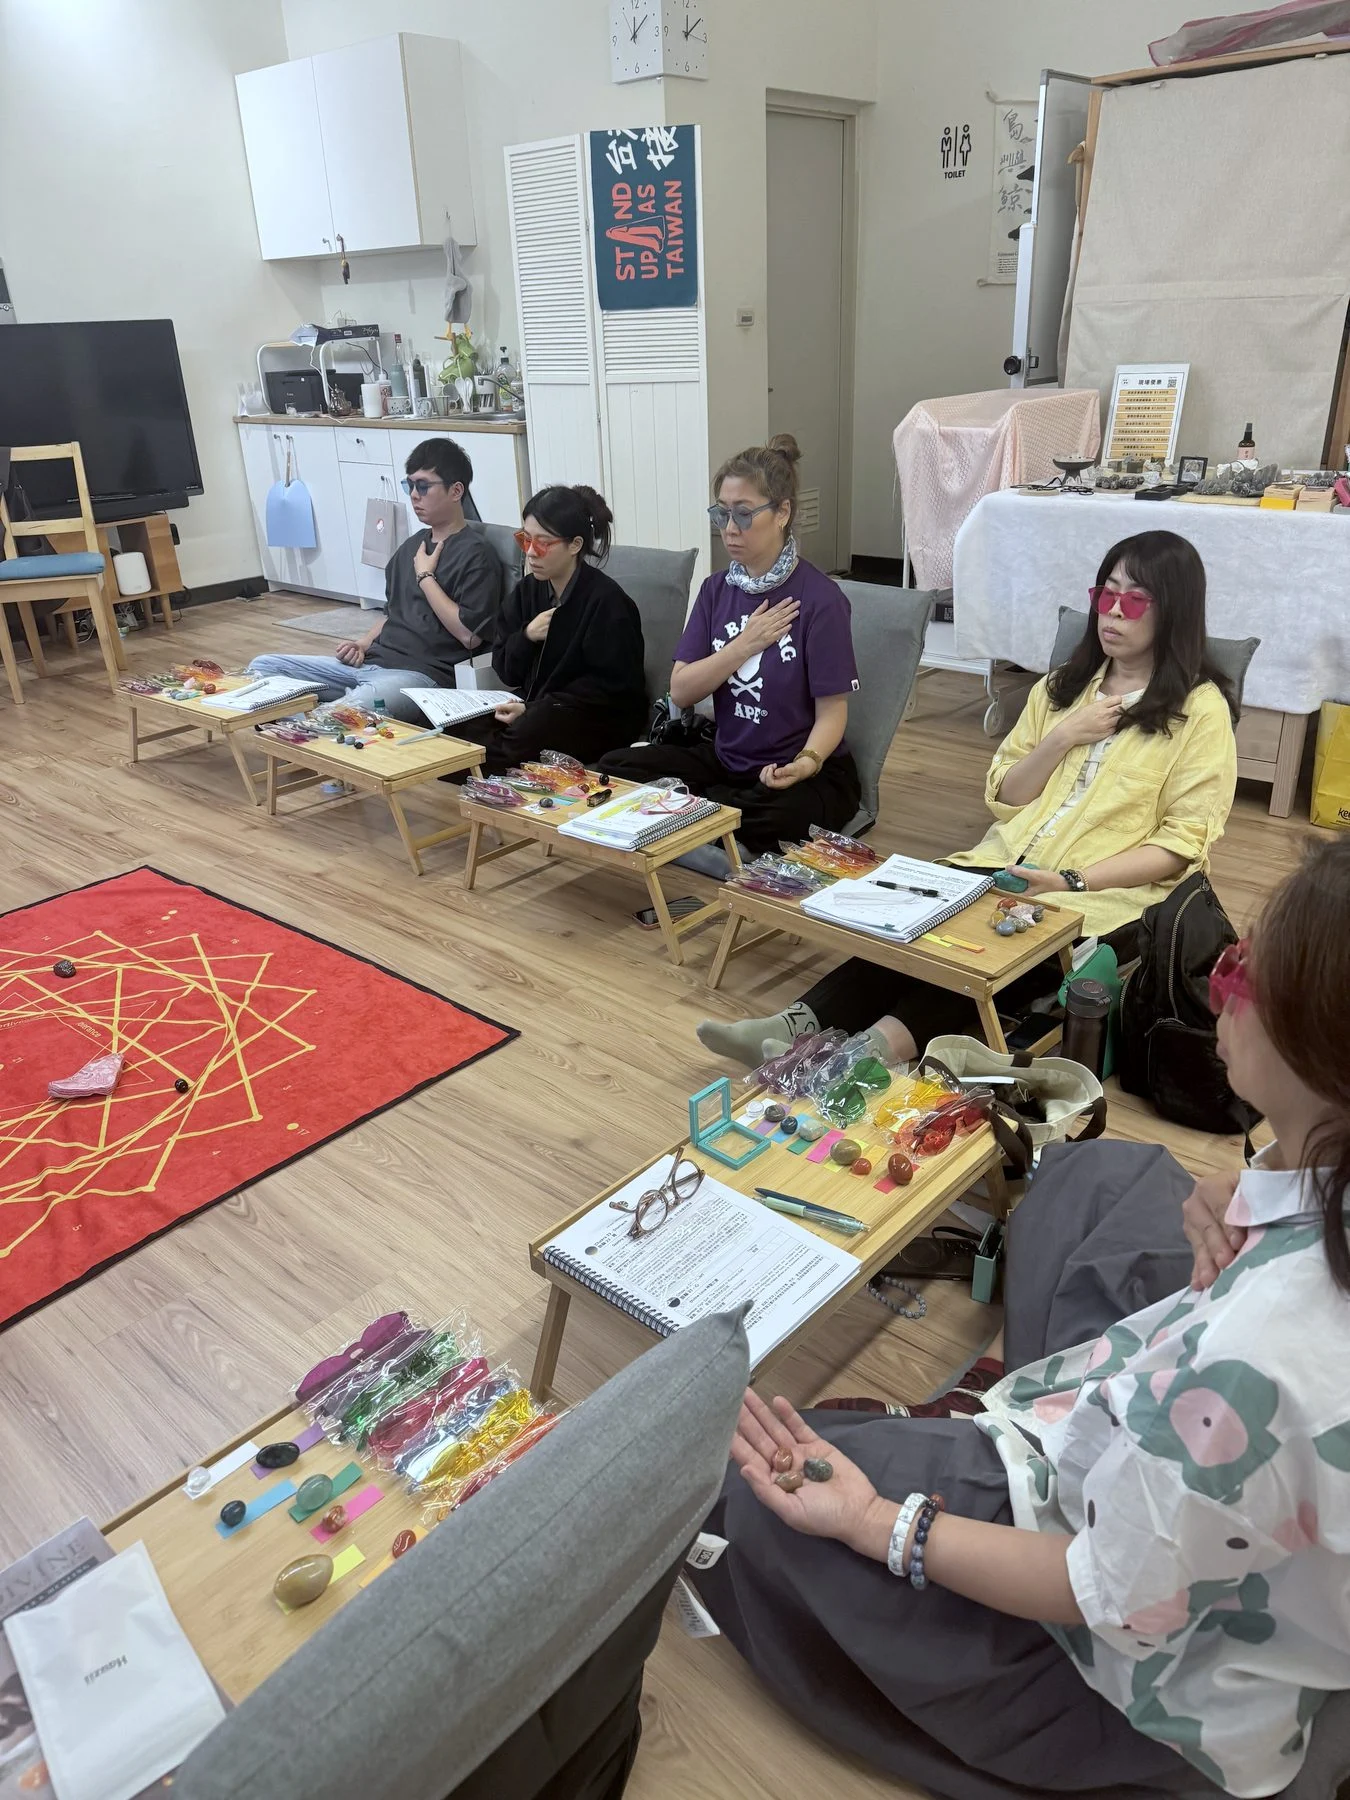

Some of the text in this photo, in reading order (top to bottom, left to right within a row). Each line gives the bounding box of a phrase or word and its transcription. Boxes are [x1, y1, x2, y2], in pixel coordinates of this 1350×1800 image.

[654, 25, 660, 37] 3
[663, 25, 669, 37] 9
[612, 35, 618, 47] 9
[702, 32, 708, 44] 3
[634, 61, 640, 74] 6
[684, 61, 690, 73] 6
[943, 169, 967, 180] TOILET
[636, 183, 659, 280] UP AS
[663, 180, 685, 280] TAIWAN
[734, 701, 761, 725] APE
